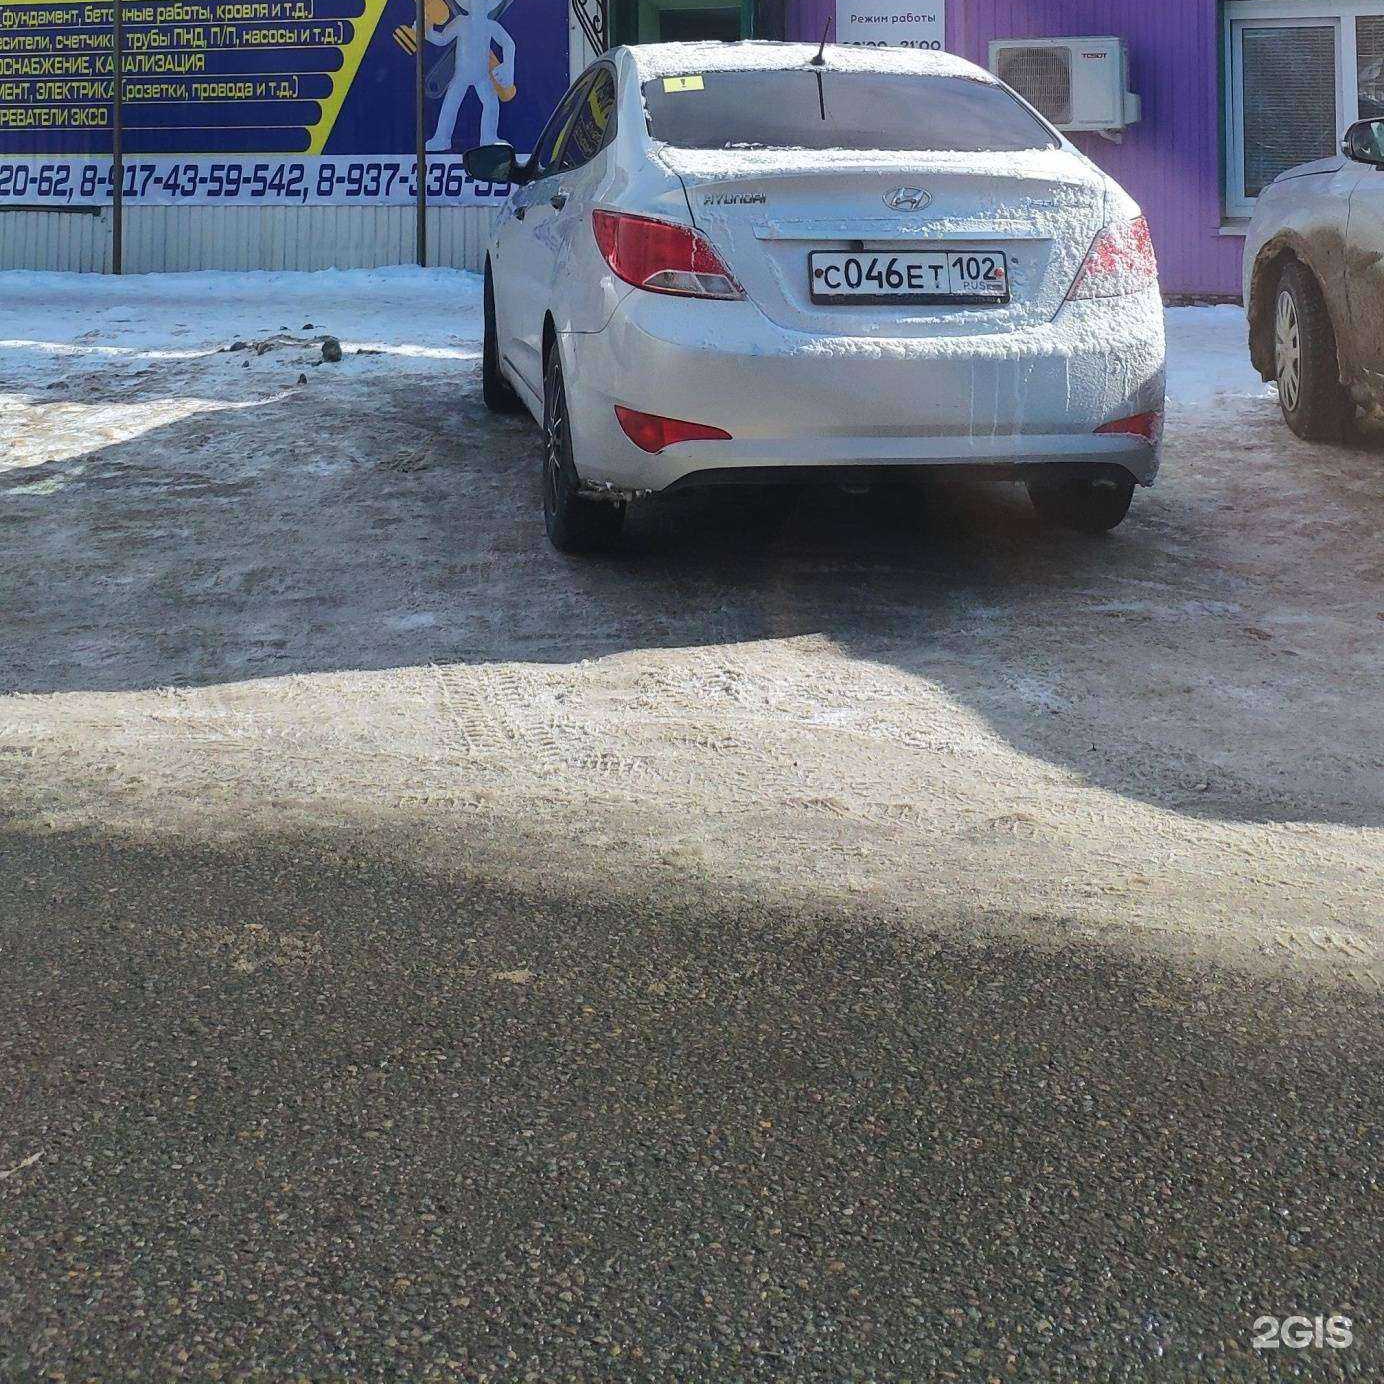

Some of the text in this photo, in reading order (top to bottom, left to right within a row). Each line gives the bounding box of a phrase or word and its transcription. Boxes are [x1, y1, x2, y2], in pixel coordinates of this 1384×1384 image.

[156, 2, 213, 26] работы,
[216, 4, 269, 22] кровля
[271, 3, 281, 18] и
[850, 12, 937, 25] Режим работы
[126, 28, 171, 50] трубы
[173, 26, 207, 49] ПНД,
[210, 25, 240, 47] П/П,
[242, 26, 298, 46] насосы
[300, 26, 310, 43] и
[313, 21, 344, 45] т.д.)
[121, 78, 189, 102] (розетки,
[192, 82, 254, 100] провода
[256, 81, 266, 97] и
[269, 75, 299, 99] т.д.)
[71, 107, 108, 126] ЭКСО
[703, 192, 767, 205] HYUNDAI
[951, 256, 997, 281] 102
